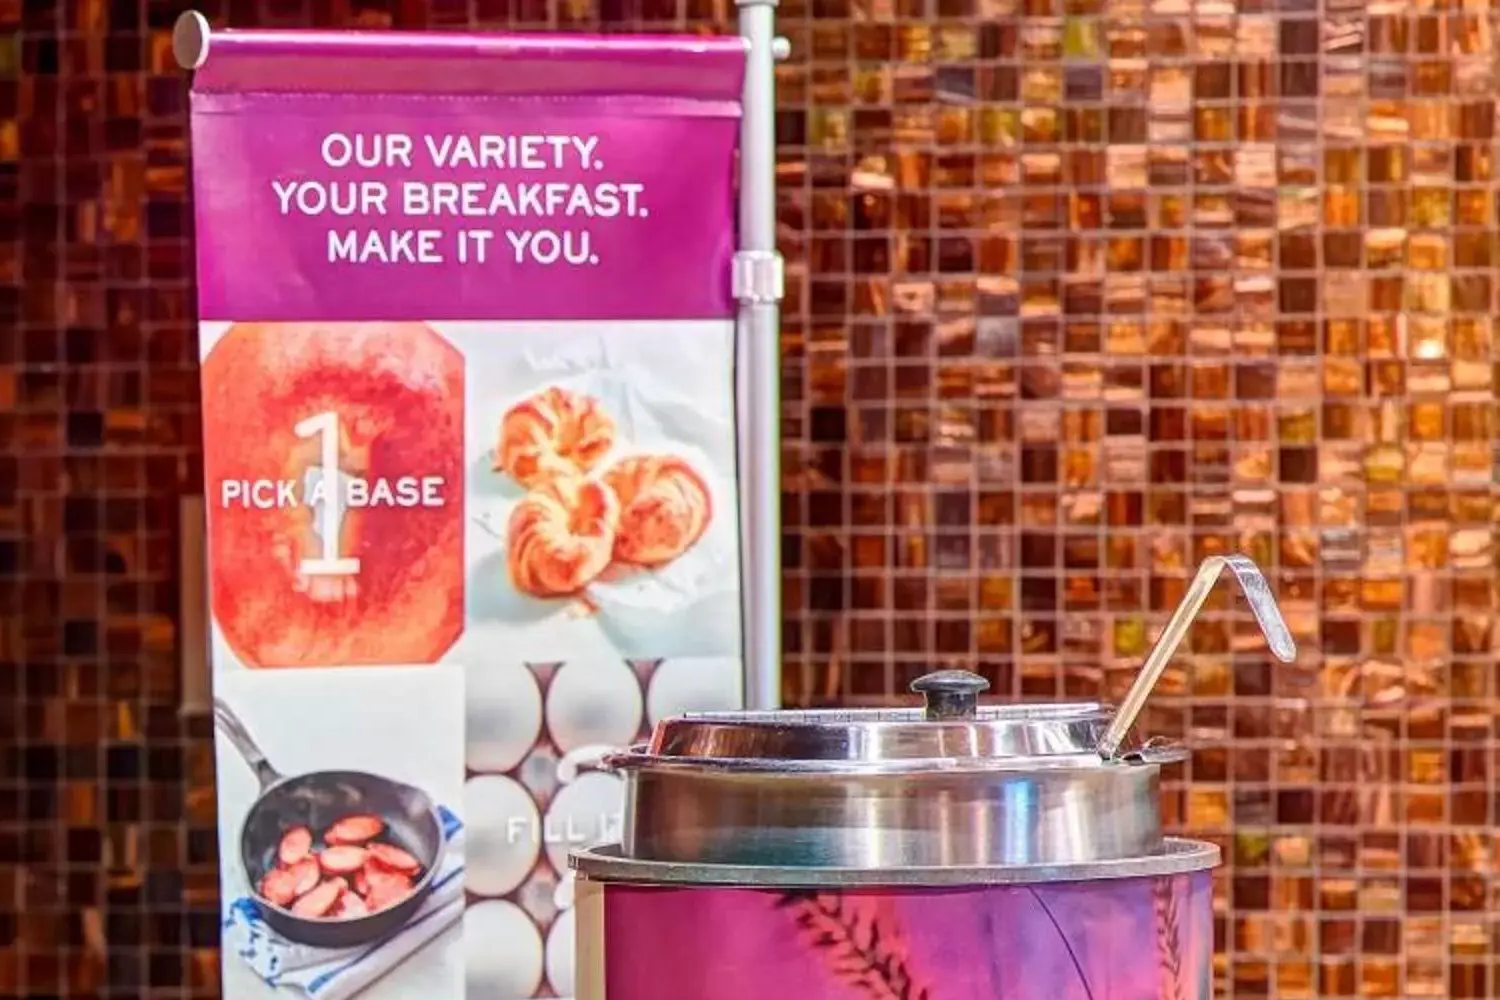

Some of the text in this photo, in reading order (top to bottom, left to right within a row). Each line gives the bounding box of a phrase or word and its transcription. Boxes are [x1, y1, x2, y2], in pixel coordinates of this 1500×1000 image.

[321, 133, 604, 170] OUR VARIETY.
[272, 181, 649, 218] YOUR BREAKFAST.
[327, 229, 600, 265] MAKE IT YOU.
[221, 479, 298, 508] PICK
[346, 476, 445, 507] BASE
[294, 411, 360, 575] 1
[507, 814, 586, 844] FILL
